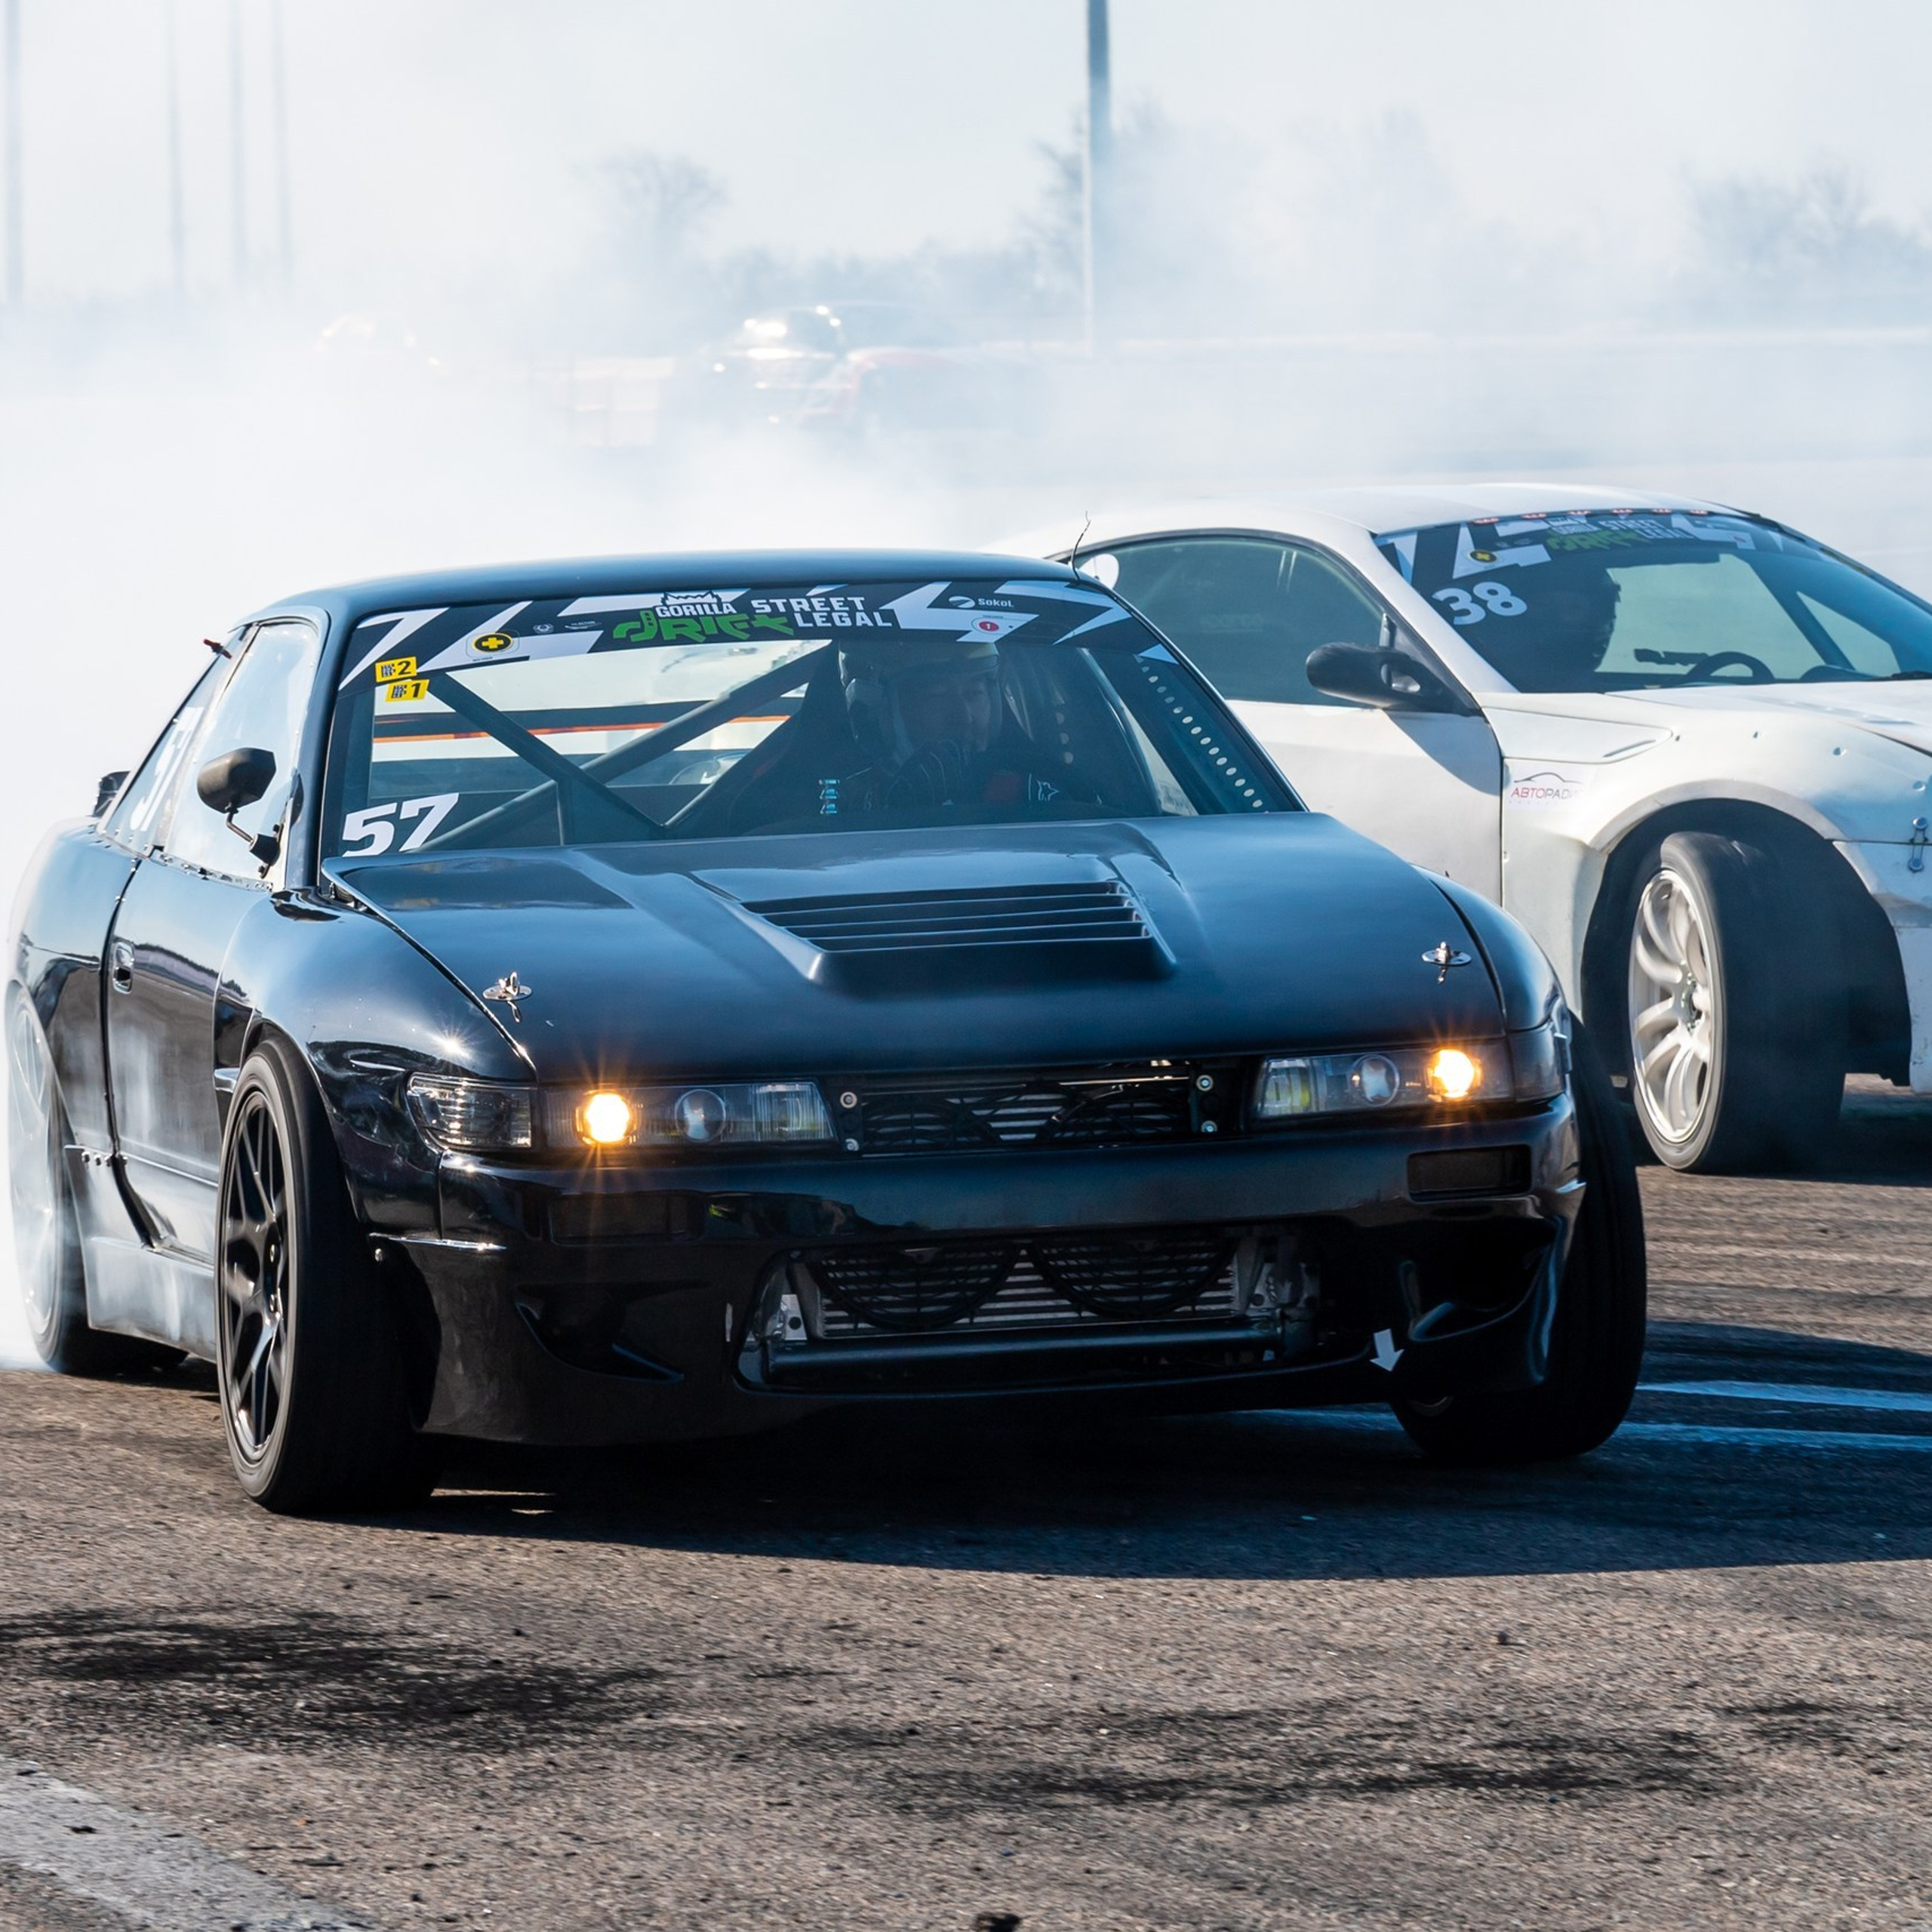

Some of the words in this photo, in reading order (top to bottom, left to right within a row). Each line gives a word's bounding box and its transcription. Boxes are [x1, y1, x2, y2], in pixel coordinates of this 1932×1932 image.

[655, 604, 737, 618] GORILLA
[751, 597, 865, 614] STREET
[1432, 581, 1527, 625] 38
[794, 611, 892, 627] LEGAL
[398, 660, 411, 675] 2
[411, 683, 421, 698] 1
[342, 792, 460, 857] 57
